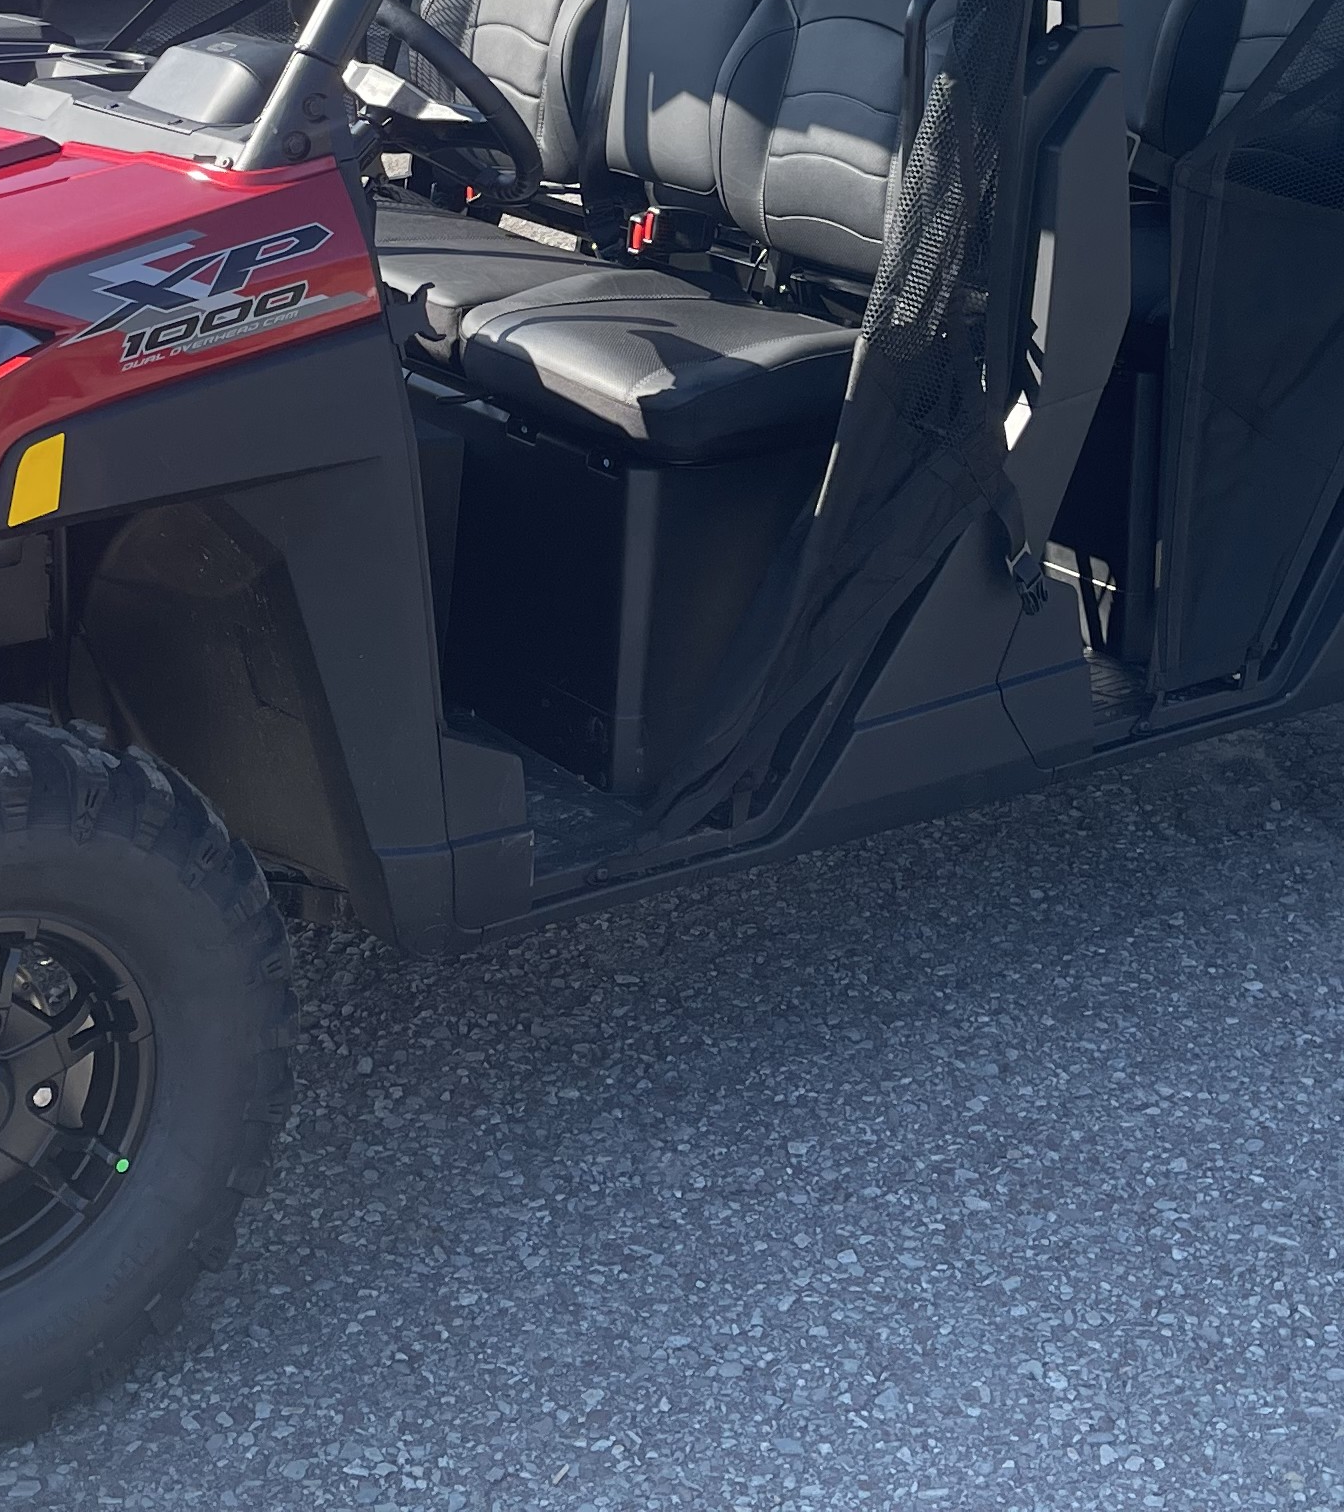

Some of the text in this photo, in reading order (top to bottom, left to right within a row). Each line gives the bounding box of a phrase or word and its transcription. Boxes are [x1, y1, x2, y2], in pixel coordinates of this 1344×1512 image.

[58, 222, 335, 348] XP
[120, 280, 309, 363] 1000
[121, 309, 299, 371] DUAL OVERHEAD CAM
